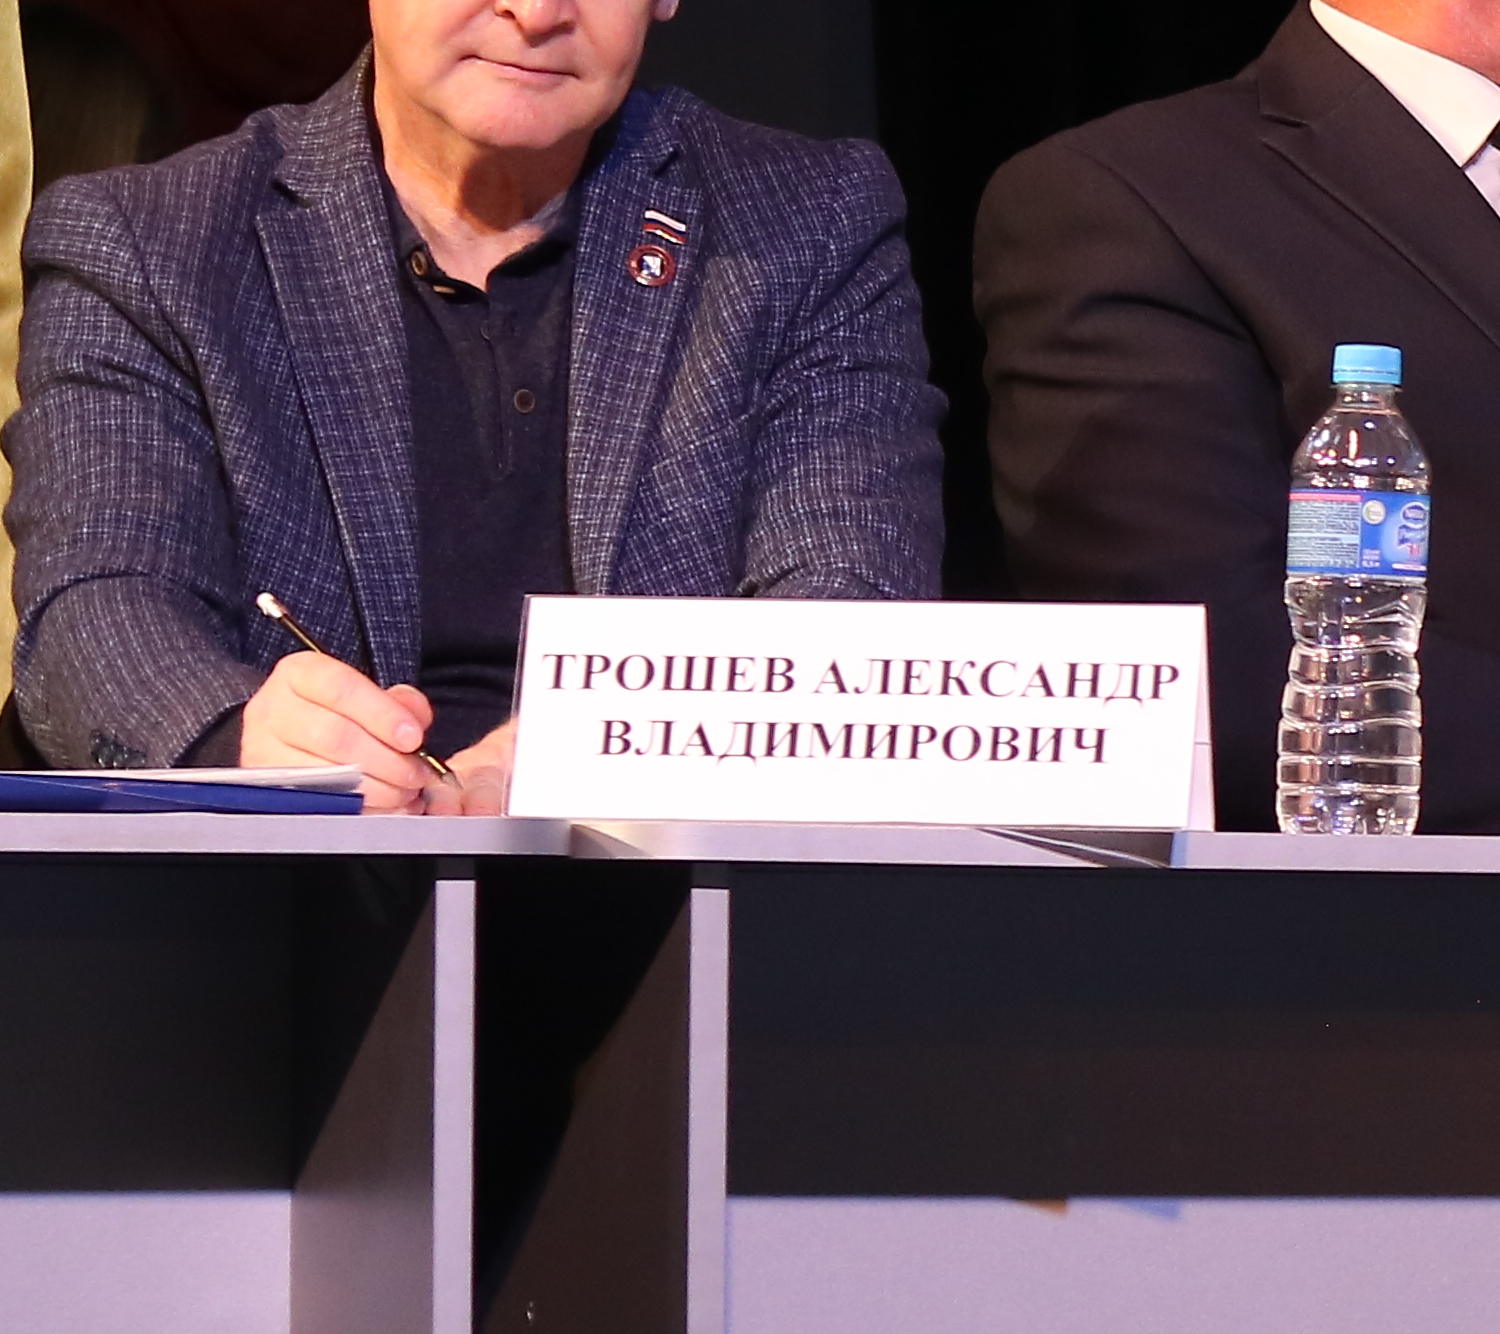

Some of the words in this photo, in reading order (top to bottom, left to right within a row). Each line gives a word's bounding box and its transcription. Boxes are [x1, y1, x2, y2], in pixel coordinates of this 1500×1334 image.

[543, 654, 796, 694] ТРОШЕВ
[813, 658, 1180, 704] АЛЕКСАНДР
[598, 719, 1108, 764] ВЛАДИМИРОВИЧ
